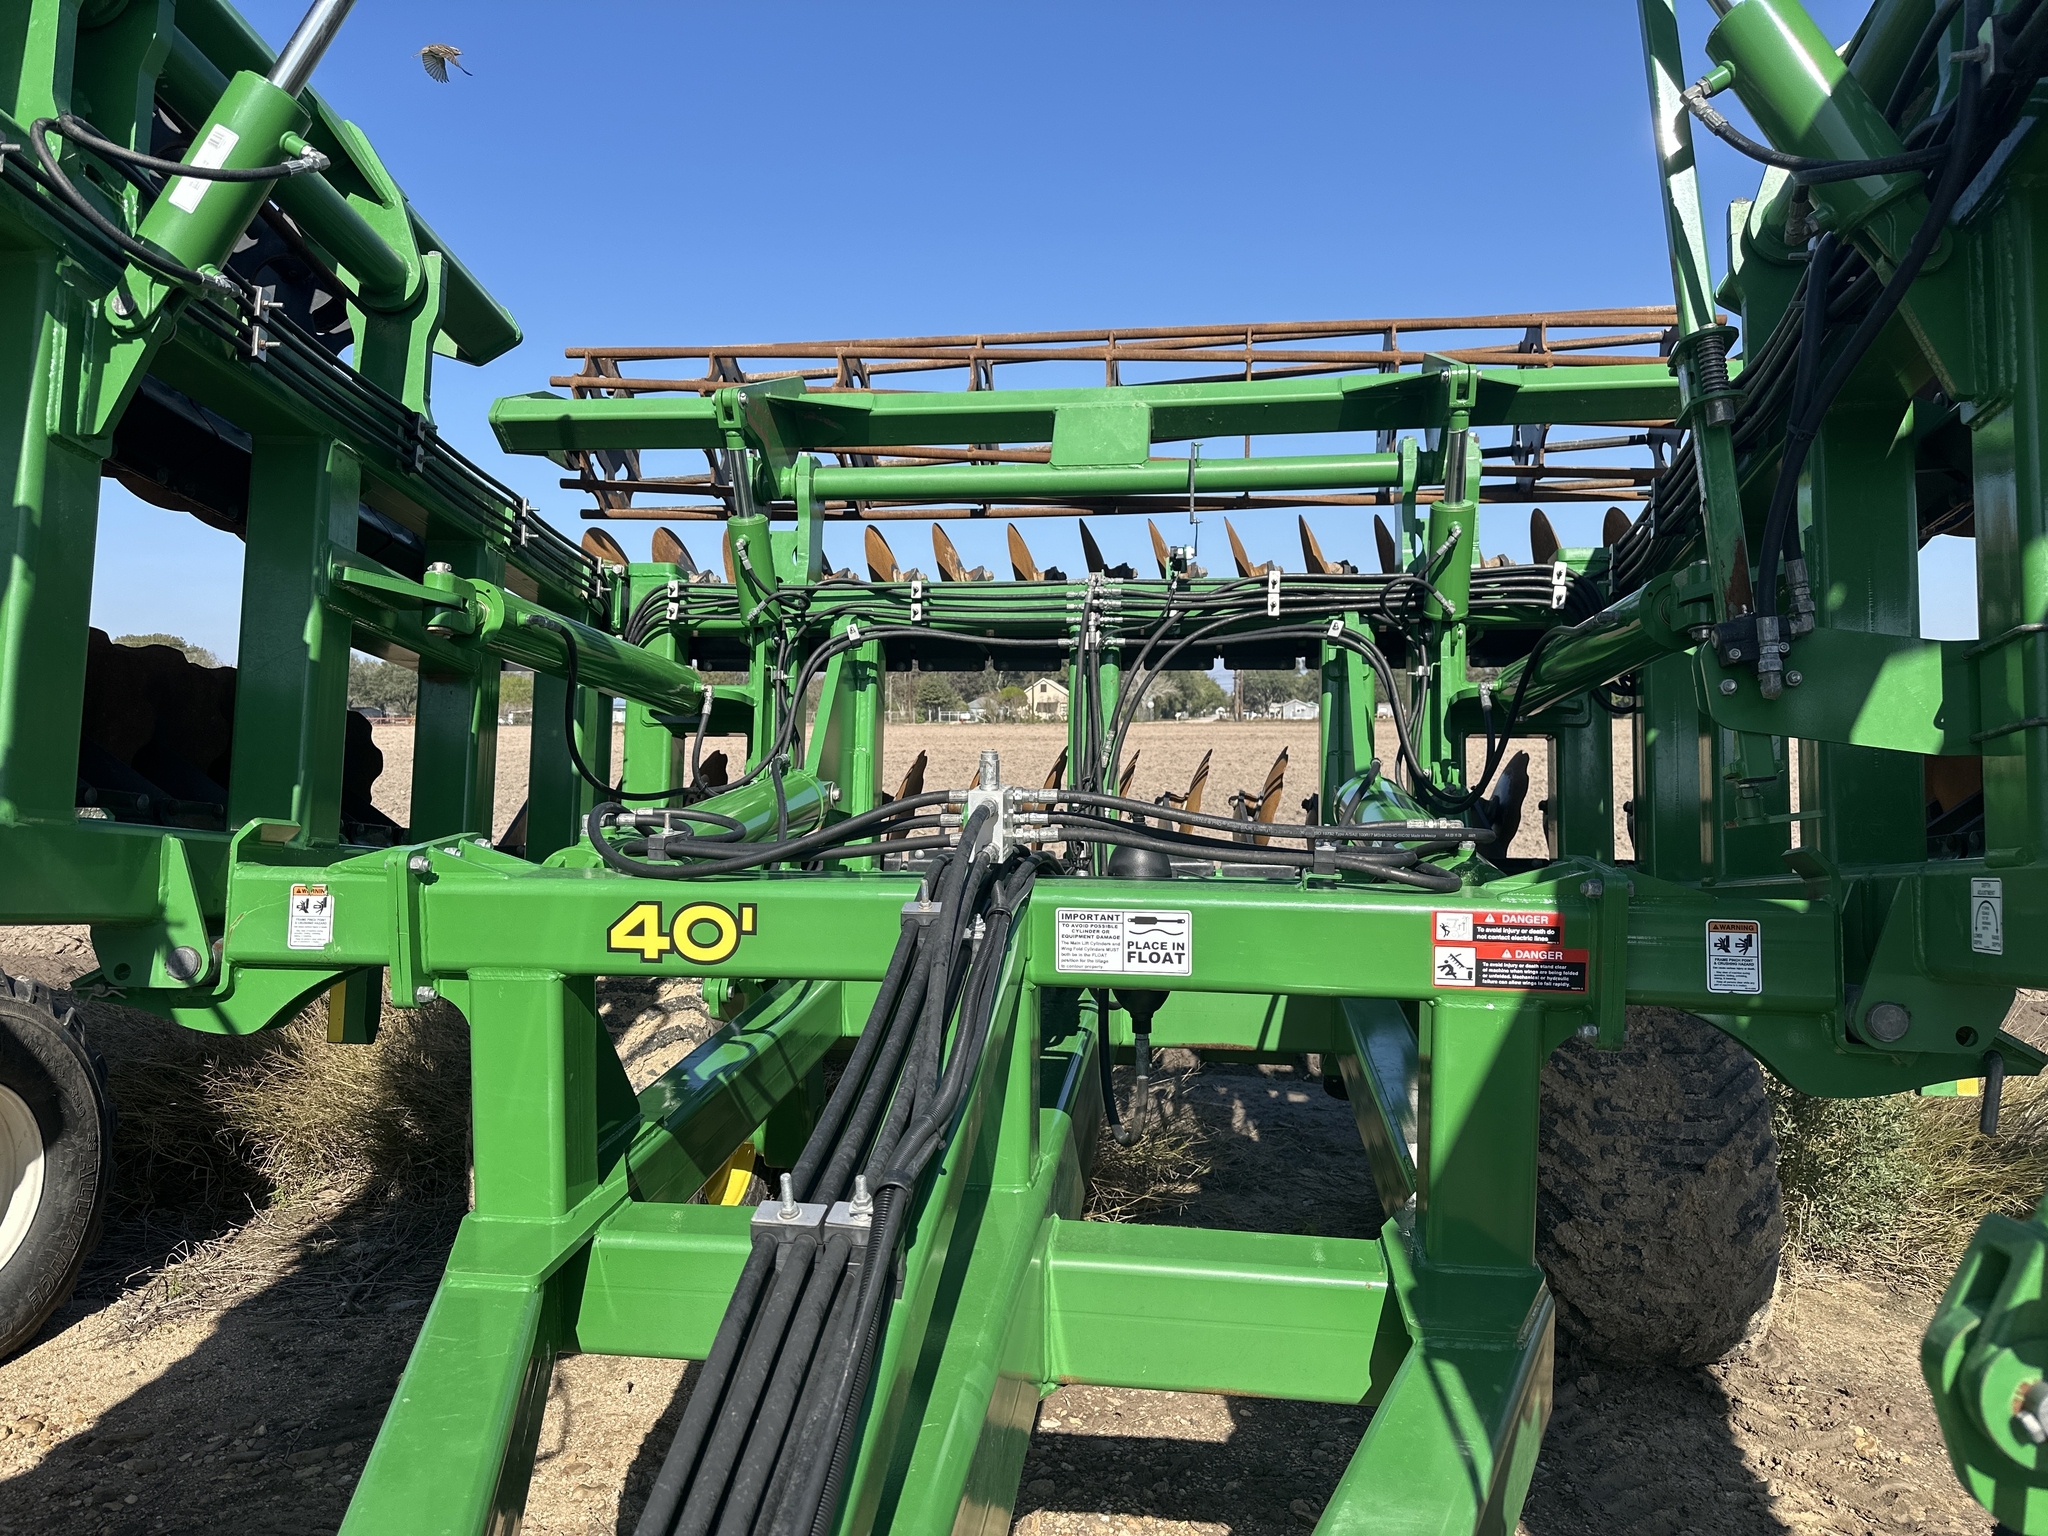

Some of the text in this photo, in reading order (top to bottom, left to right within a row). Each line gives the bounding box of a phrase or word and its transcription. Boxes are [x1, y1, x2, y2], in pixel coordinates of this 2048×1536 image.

[1061, 913, 1121, 921] IMPORTANT
[1502, 914, 1549, 925] DANGER
[607, 901, 757, 965] 40'
[1127, 941, 1185, 951] PLACE IN
[1127, 951, 1186, 965] FLOAT
[1515, 950, 1563, 960] DANGER
[28, 1153, 97, 1313] ALLIANCE
